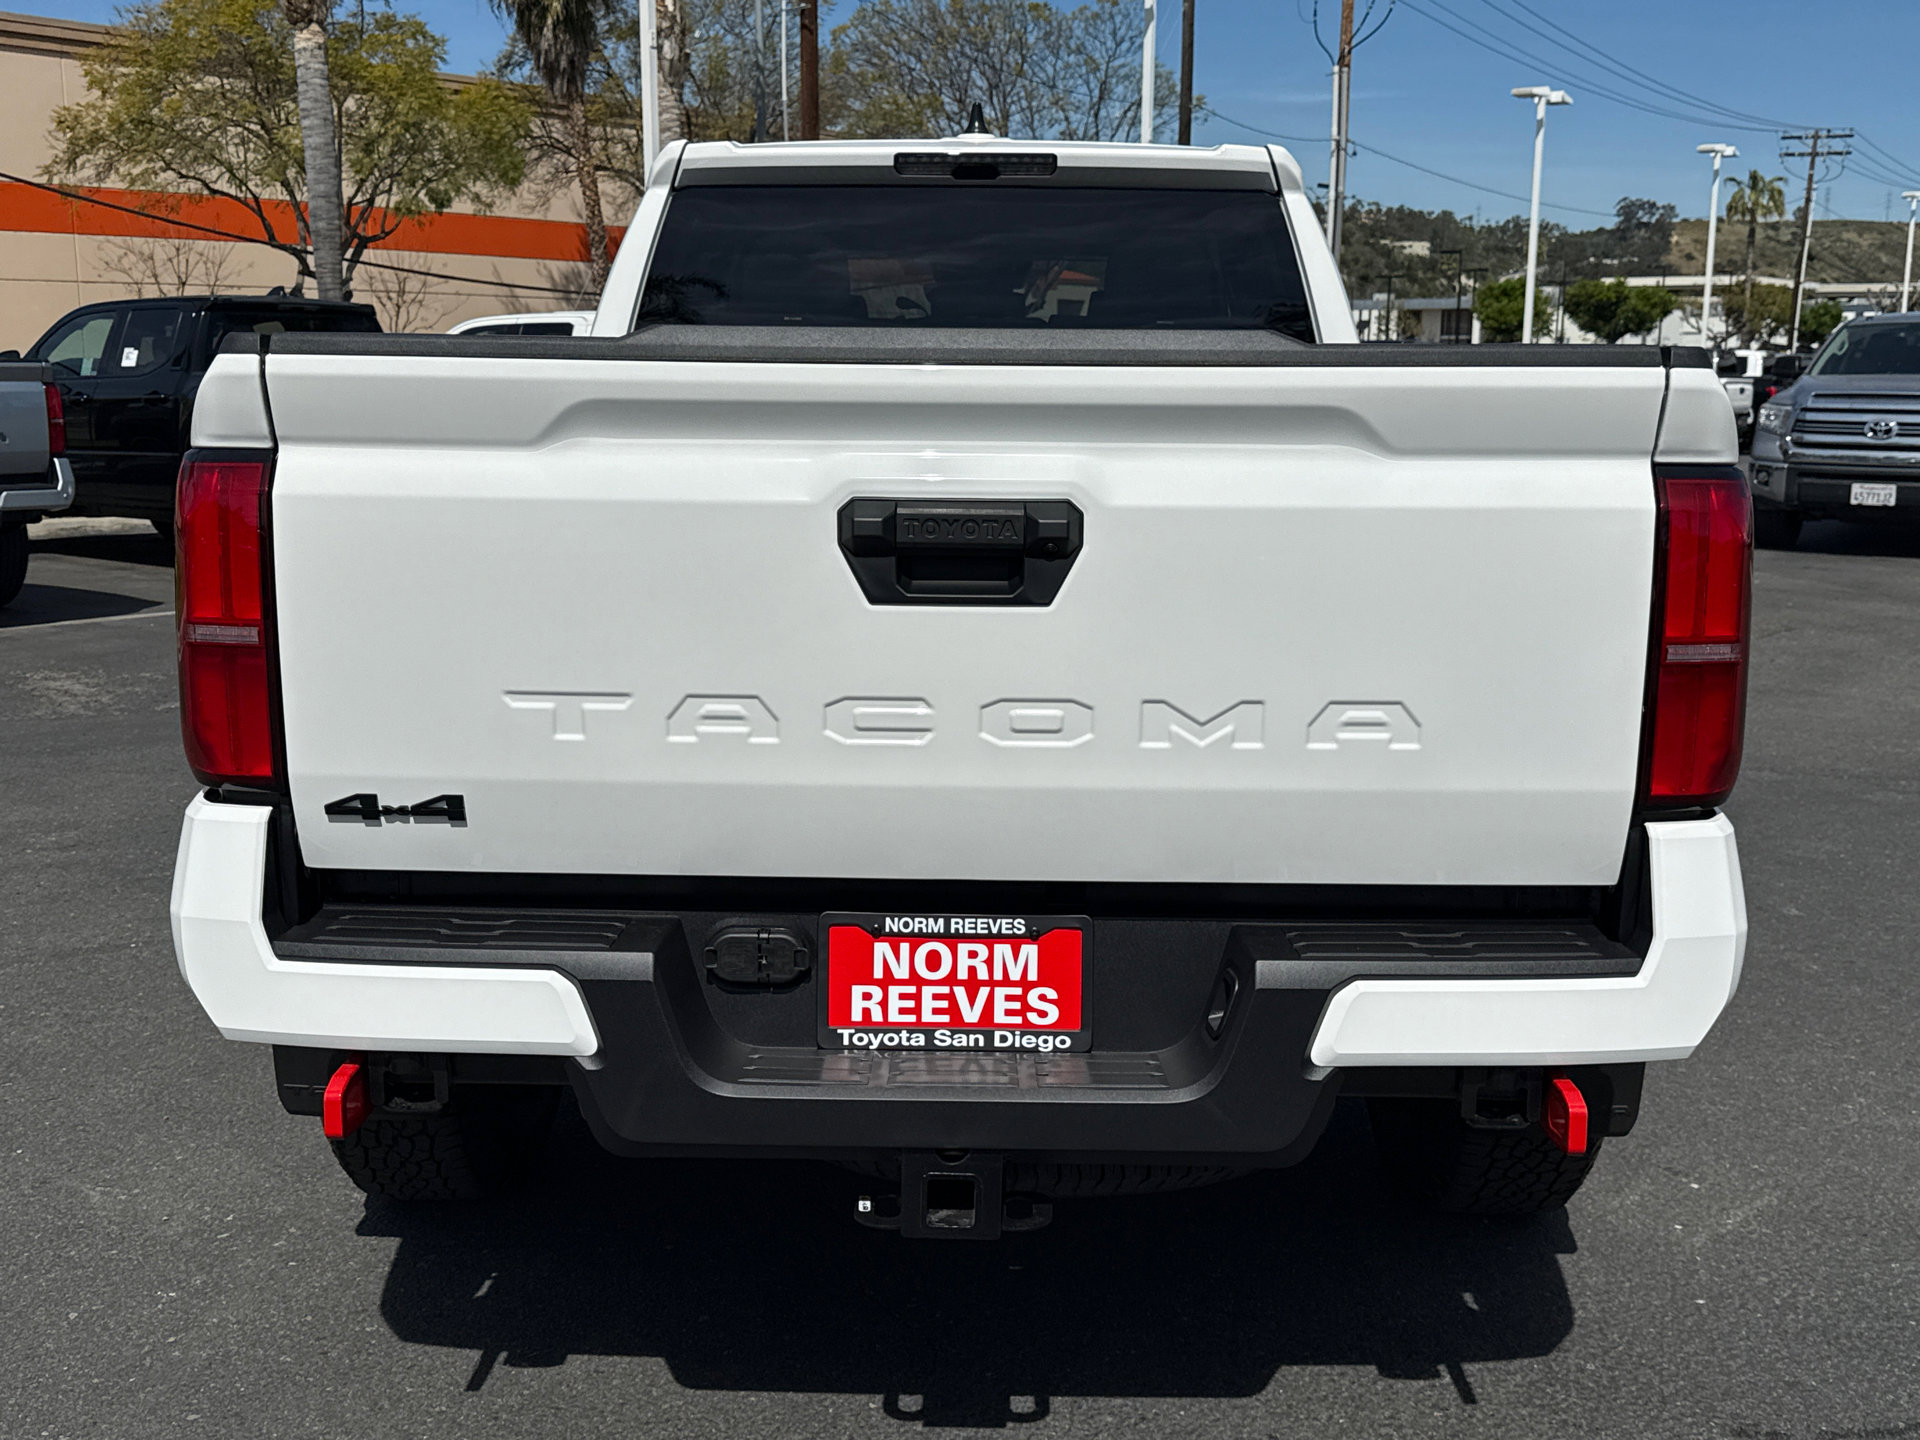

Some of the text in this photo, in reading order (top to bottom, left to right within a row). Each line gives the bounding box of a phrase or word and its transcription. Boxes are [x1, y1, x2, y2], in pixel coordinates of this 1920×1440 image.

[903, 518, 1019, 540] TOYOTA
[503, 691, 1422, 751] TACOMA
[885, 917, 1026, 935] NORM REEVES
[873, 941, 1039, 982] NORM
[850, 984, 1060, 1026] REEVES
[837, 1028, 1072, 1053] Toyota San Diego
